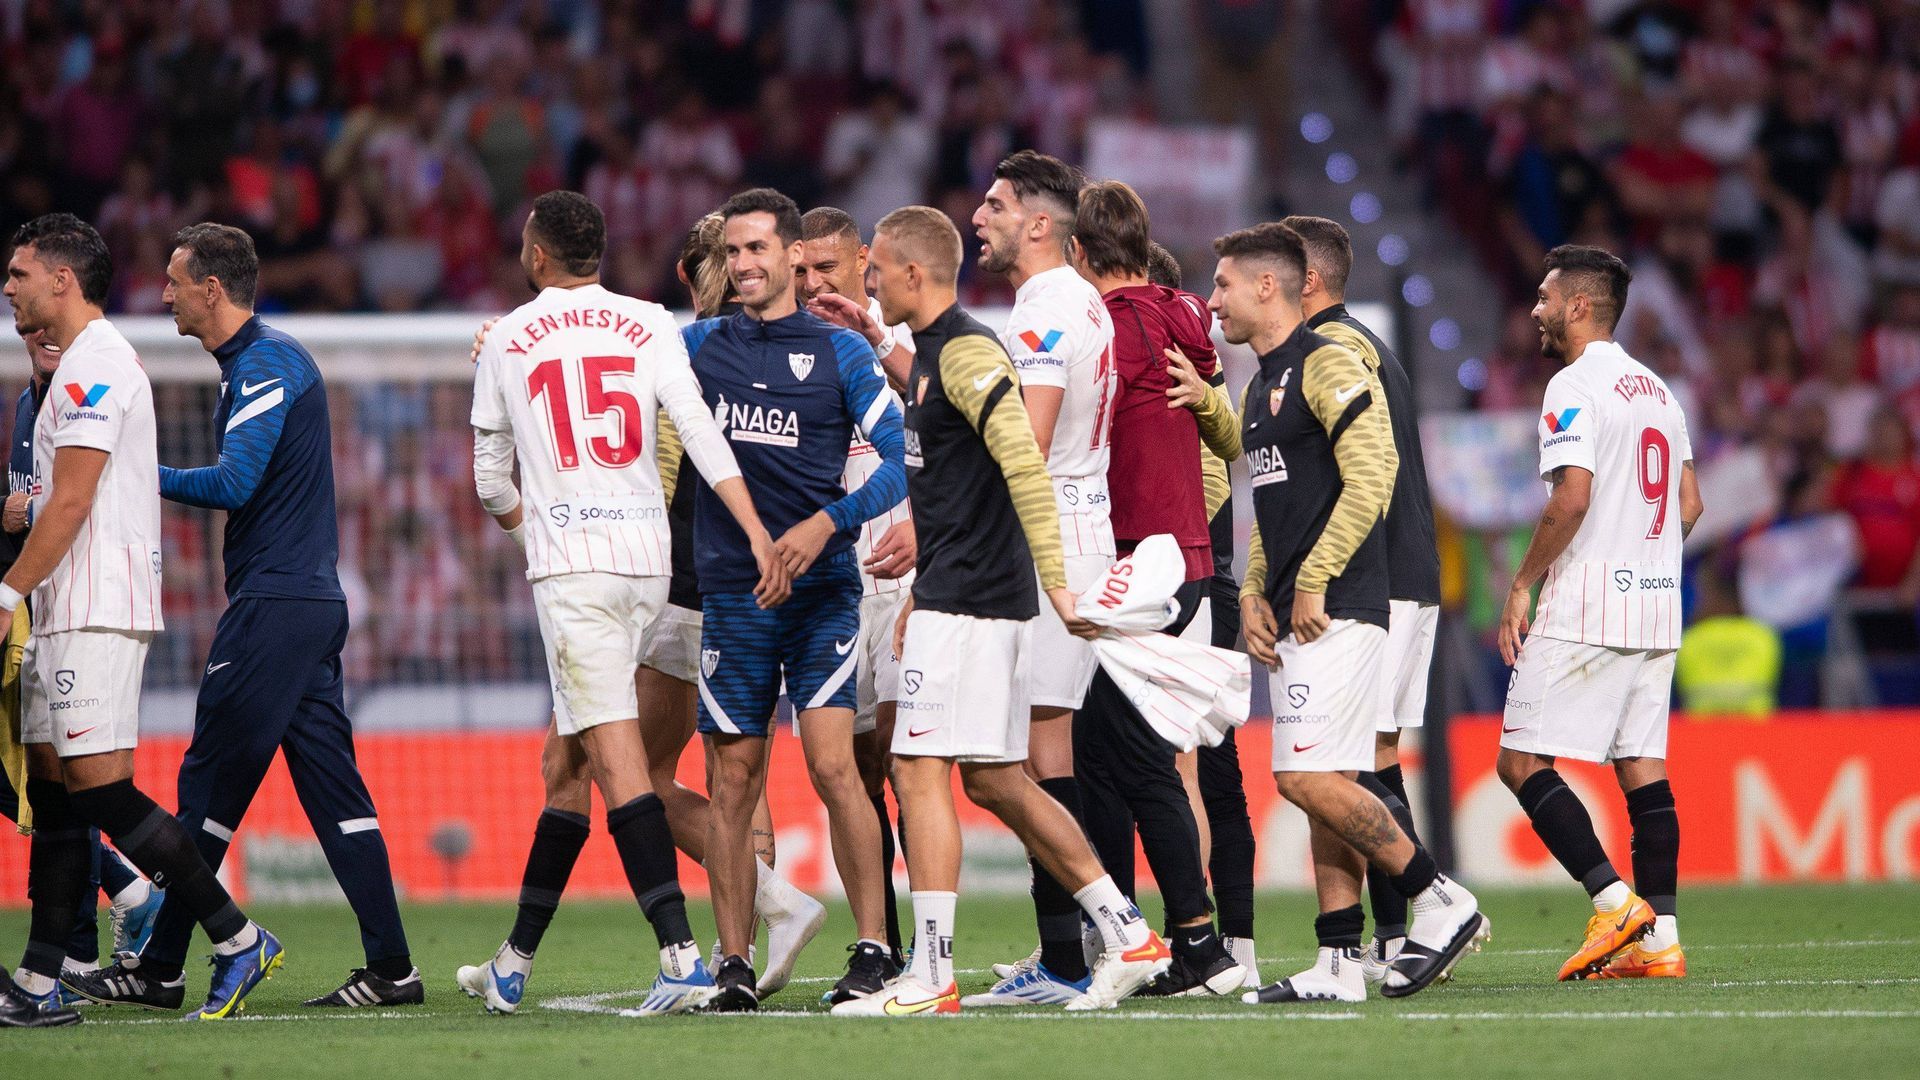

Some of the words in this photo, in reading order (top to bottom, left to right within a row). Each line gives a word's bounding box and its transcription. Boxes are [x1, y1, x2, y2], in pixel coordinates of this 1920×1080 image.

[1019, 356, 1064, 368] Valvoline
[64, 410, 110, 422] Valvoline
[524, 355, 643, 473] 15
[730, 402, 800, 436] NAGA
[1246, 444, 1287, 477] NAGA
[1635, 425, 1671, 541] 9
